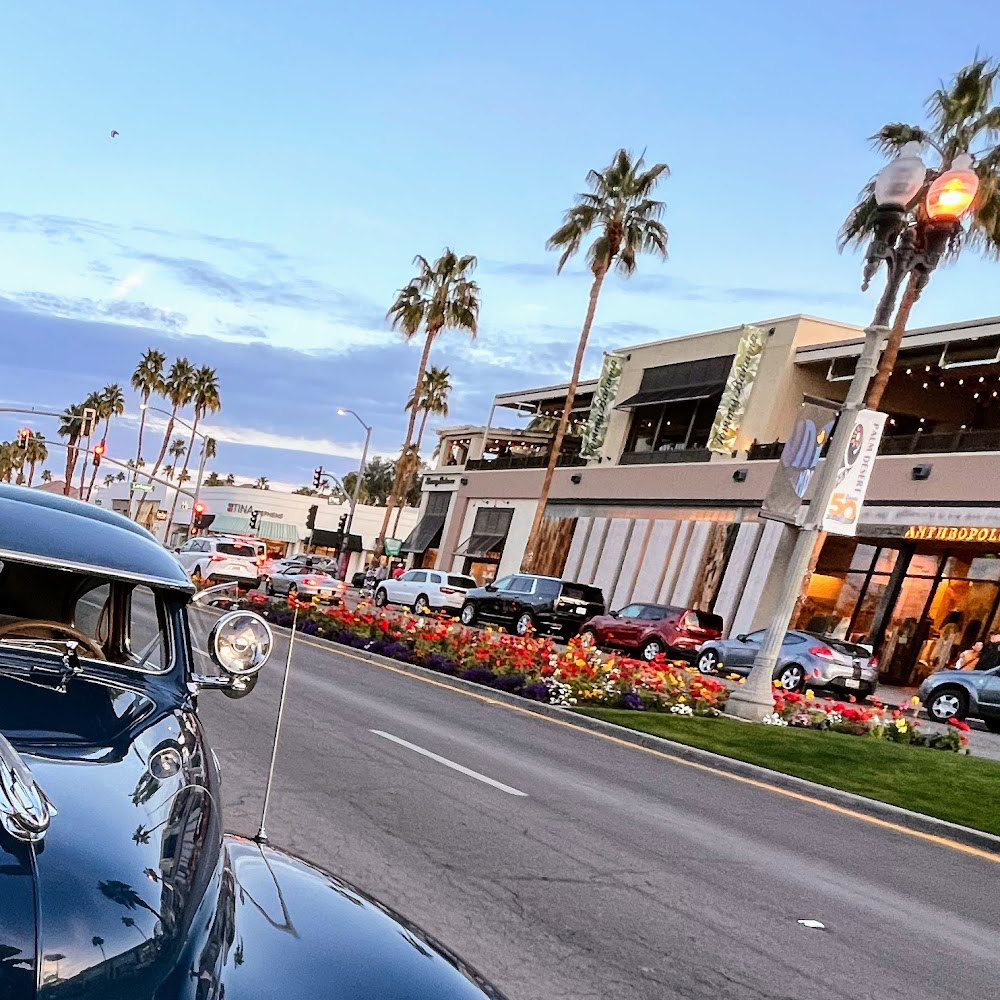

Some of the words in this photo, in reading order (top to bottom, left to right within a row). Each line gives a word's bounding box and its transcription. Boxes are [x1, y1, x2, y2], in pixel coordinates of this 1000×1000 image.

[866, 422, 879, 452] PALM
[854, 455, 871, 492] DESERT
[829, 492, 857, 524] 50
[904, 525, 1000, 542] ANTHROPOL
